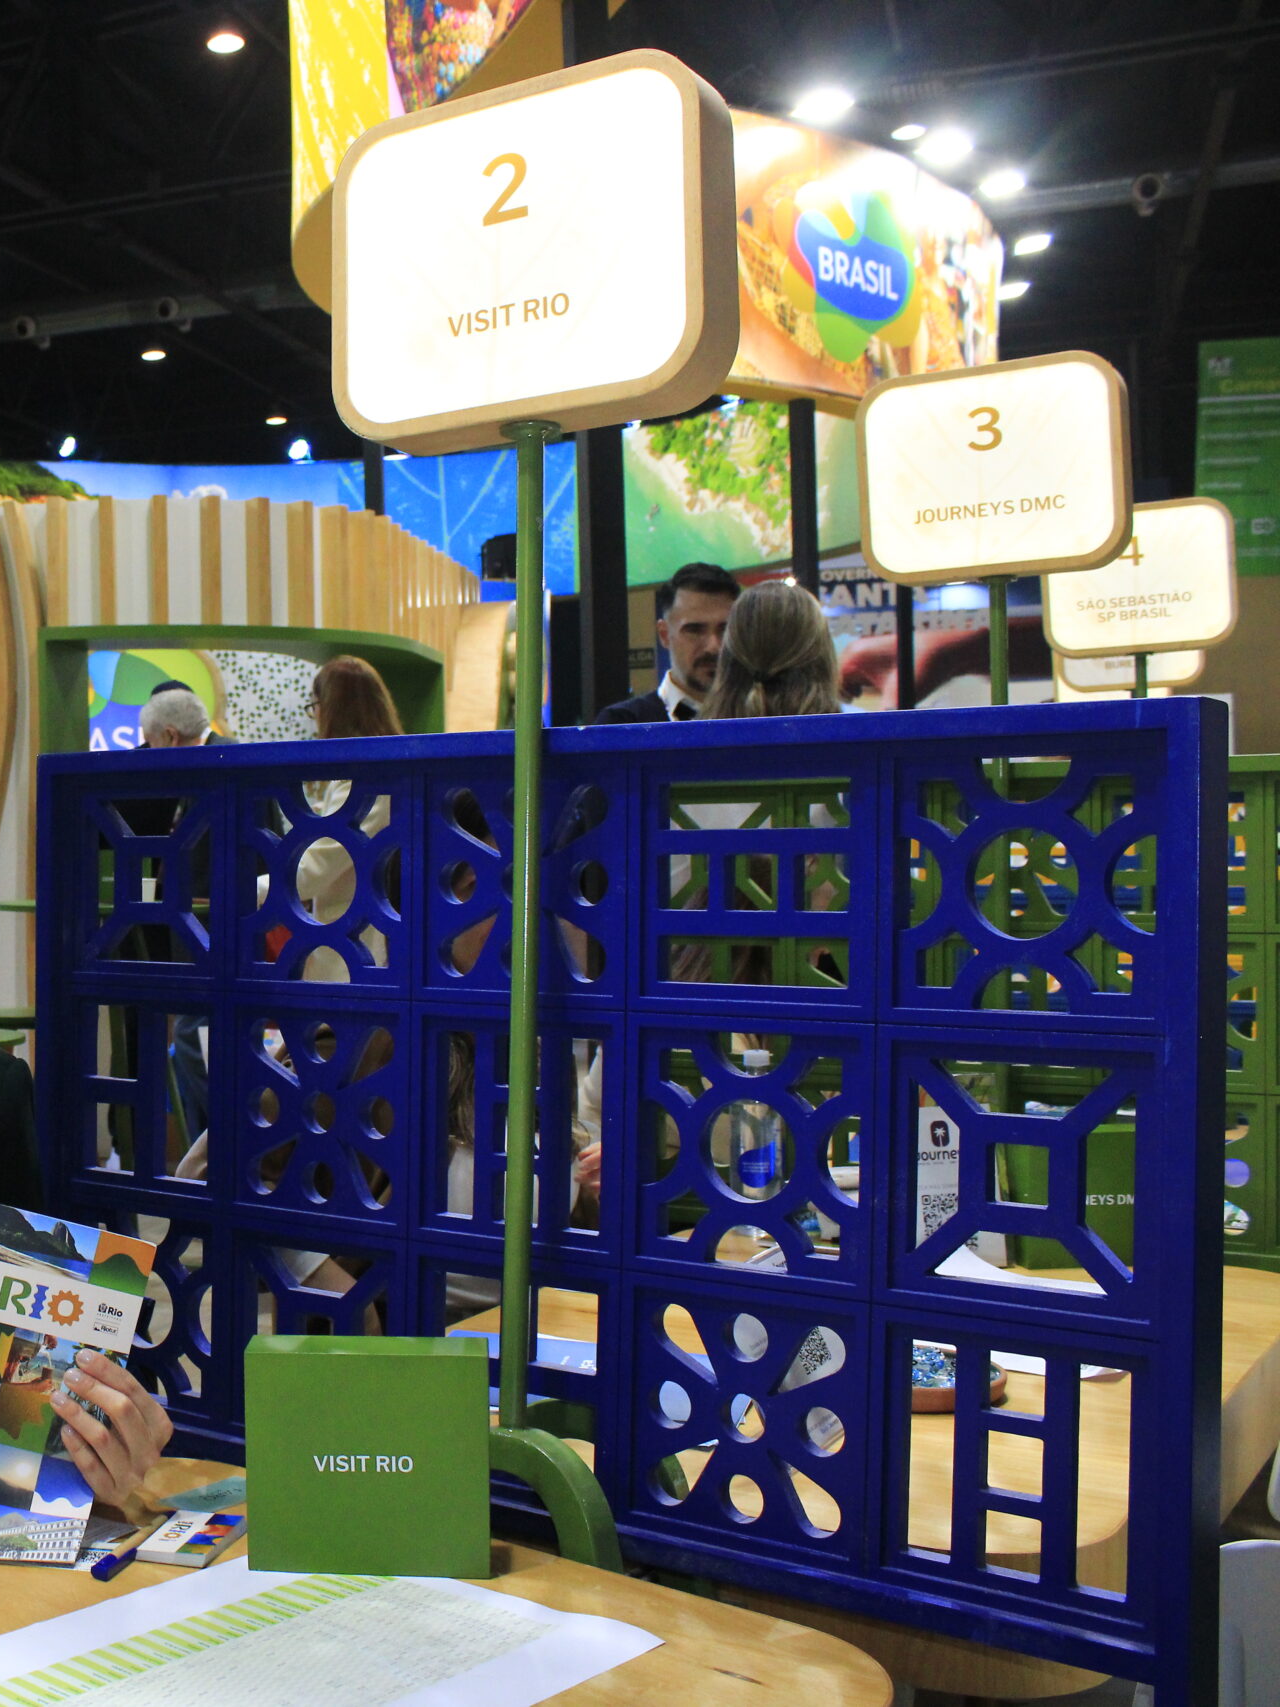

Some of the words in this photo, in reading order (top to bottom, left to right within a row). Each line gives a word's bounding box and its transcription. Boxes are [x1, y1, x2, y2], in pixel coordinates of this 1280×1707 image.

[482, 153, 528, 227] 2
[818, 246, 899, 301] BRASIL
[448, 303, 516, 337] VISIT
[524, 293, 570, 322] RIO
[968, 406, 1002, 451] 3
[915, 500, 1015, 524] JOURNEYS
[1020, 494, 1066, 513] DMC
[1118, 536, 1144, 566] 4
[1076, 598, 1106, 611] SÃO
[1109, 591, 1193, 610] SEBASTIÃO
[1098, 612, 1116, 623] SP
[1120, 607, 1172, 621] BRASIL
[107, 1305, 123, 1318] Rio
[313, 1455, 370, 1472] VISIT
[376, 1455, 414, 1473] RIO
